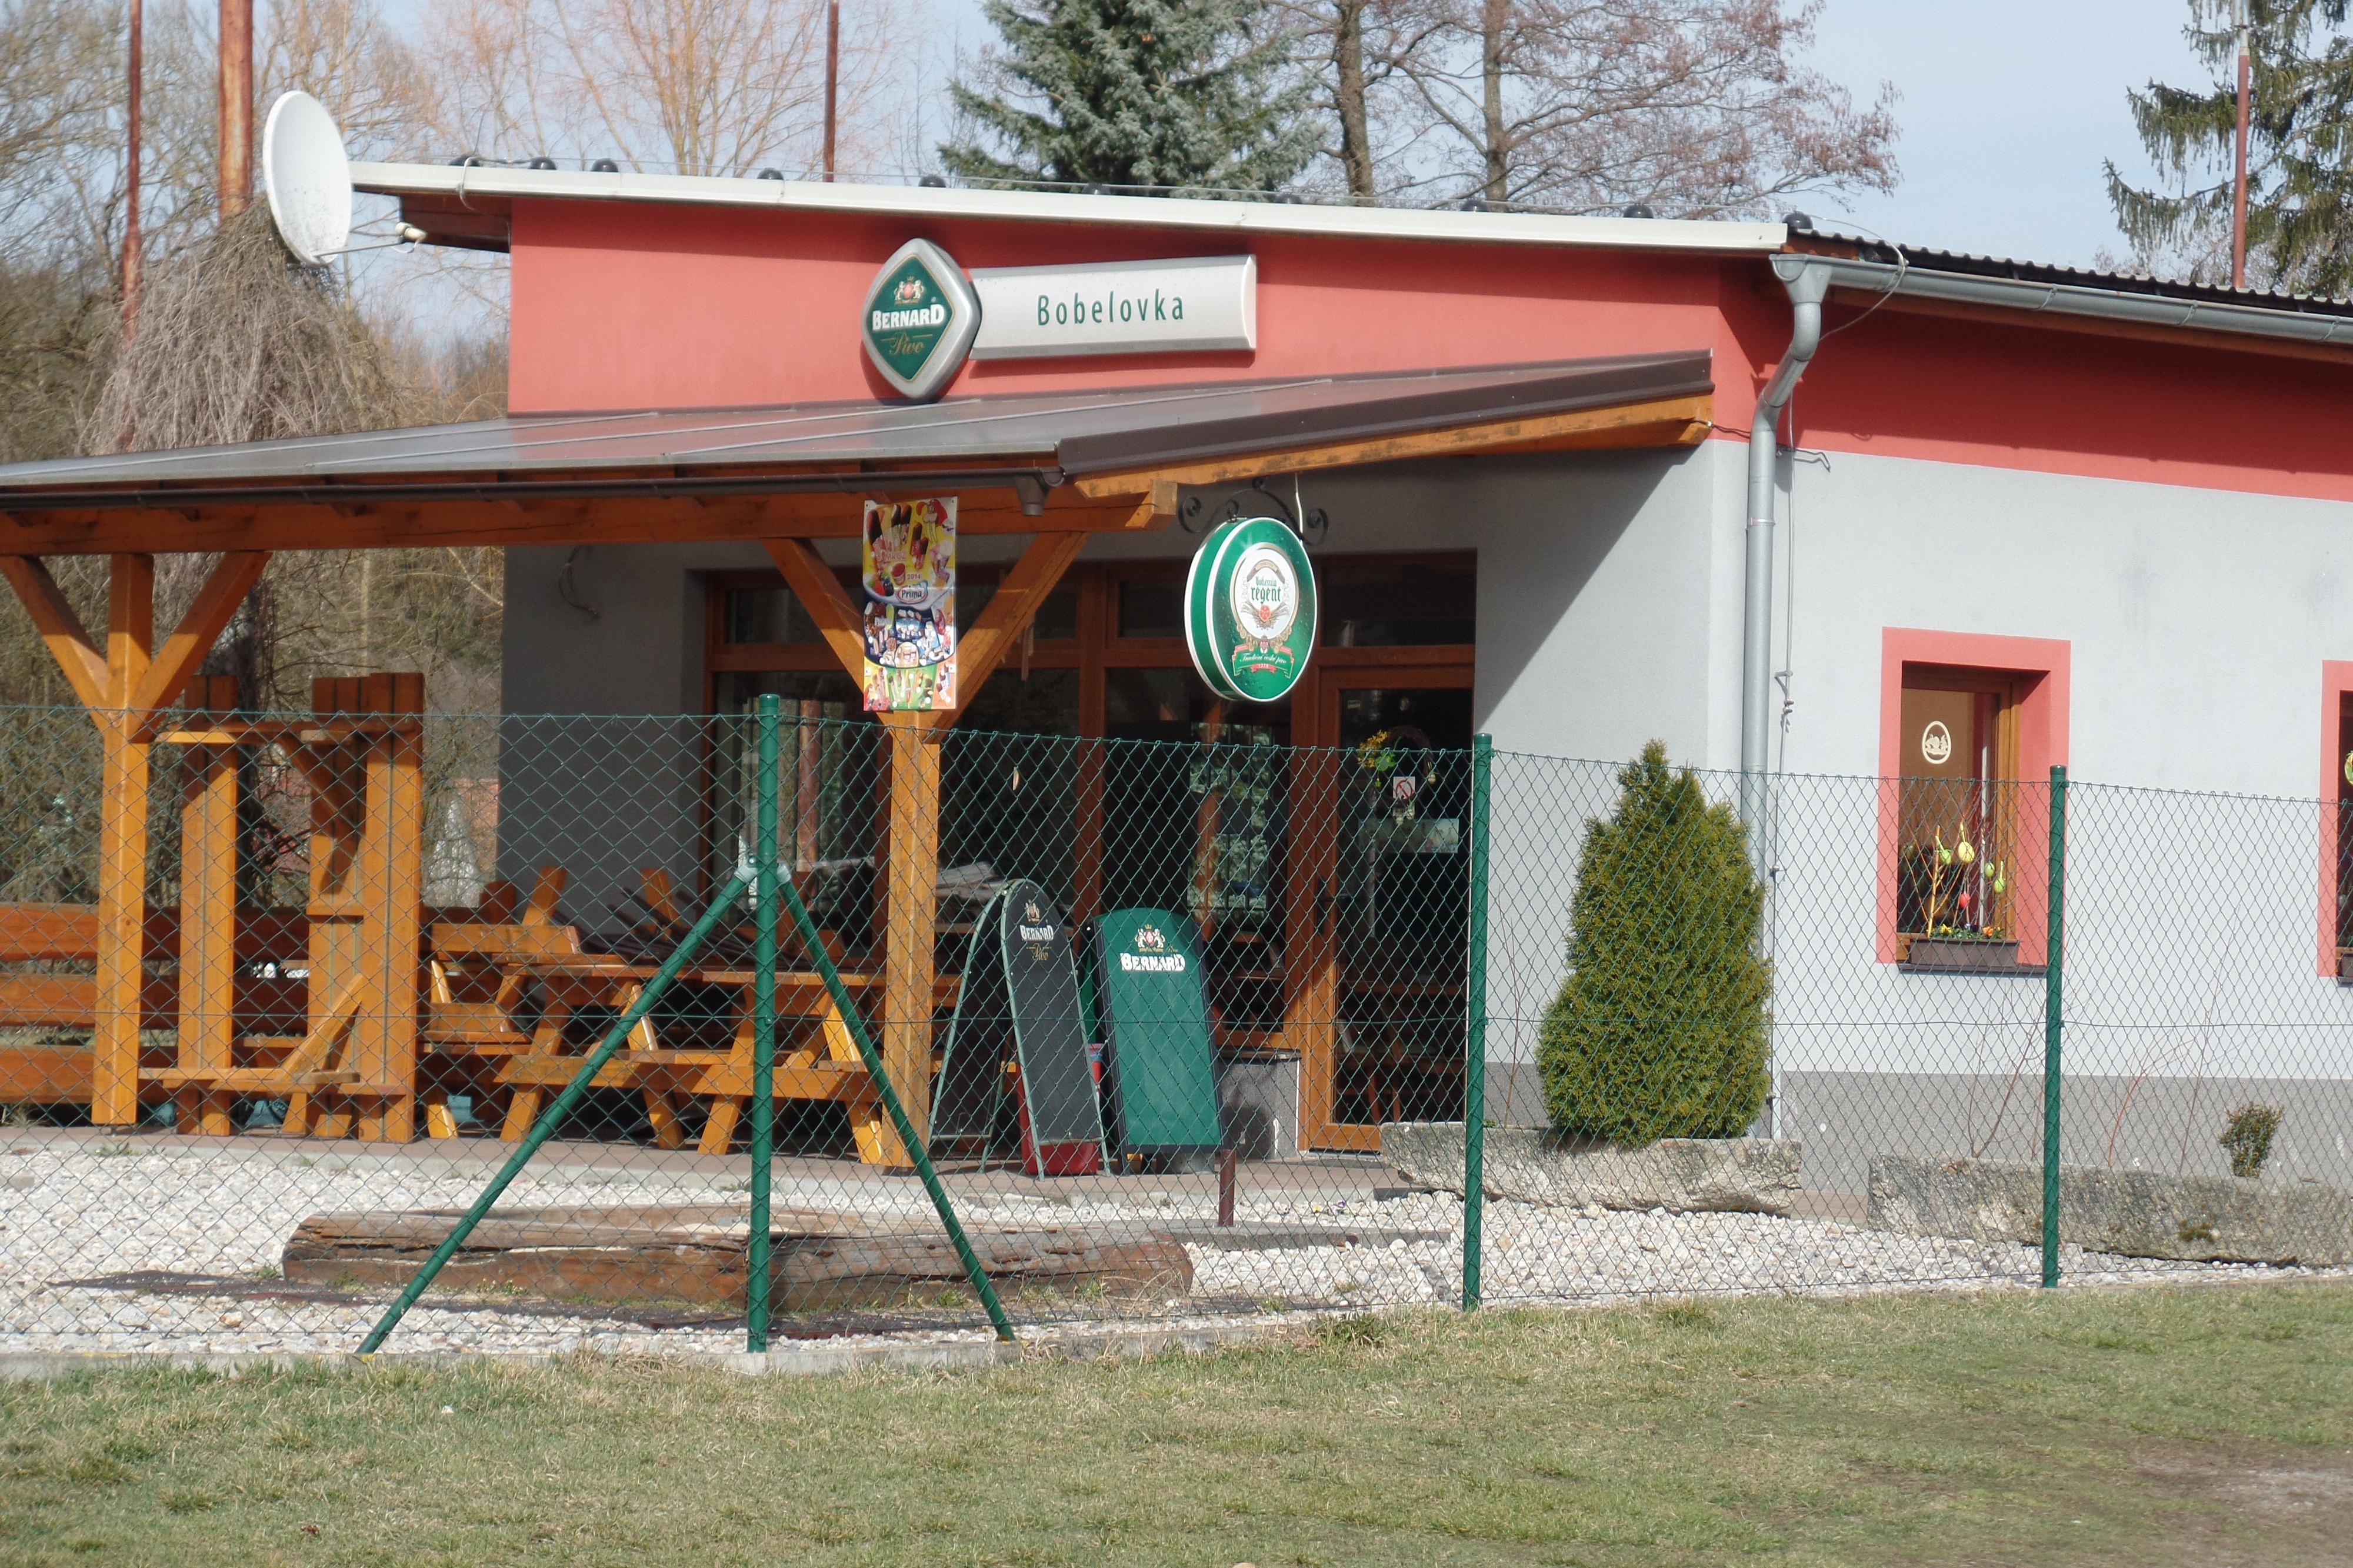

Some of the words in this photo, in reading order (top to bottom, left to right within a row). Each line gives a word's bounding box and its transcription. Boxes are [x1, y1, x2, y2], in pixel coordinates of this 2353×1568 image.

[1038, 288, 1183, 325] Bobelovka
[872, 303, 945, 331] BERNARD
[1251, 586, 1281, 604] regent
[1019, 925, 1054, 941] BERNARD
[1120, 953, 1185, 970] BERNARD
